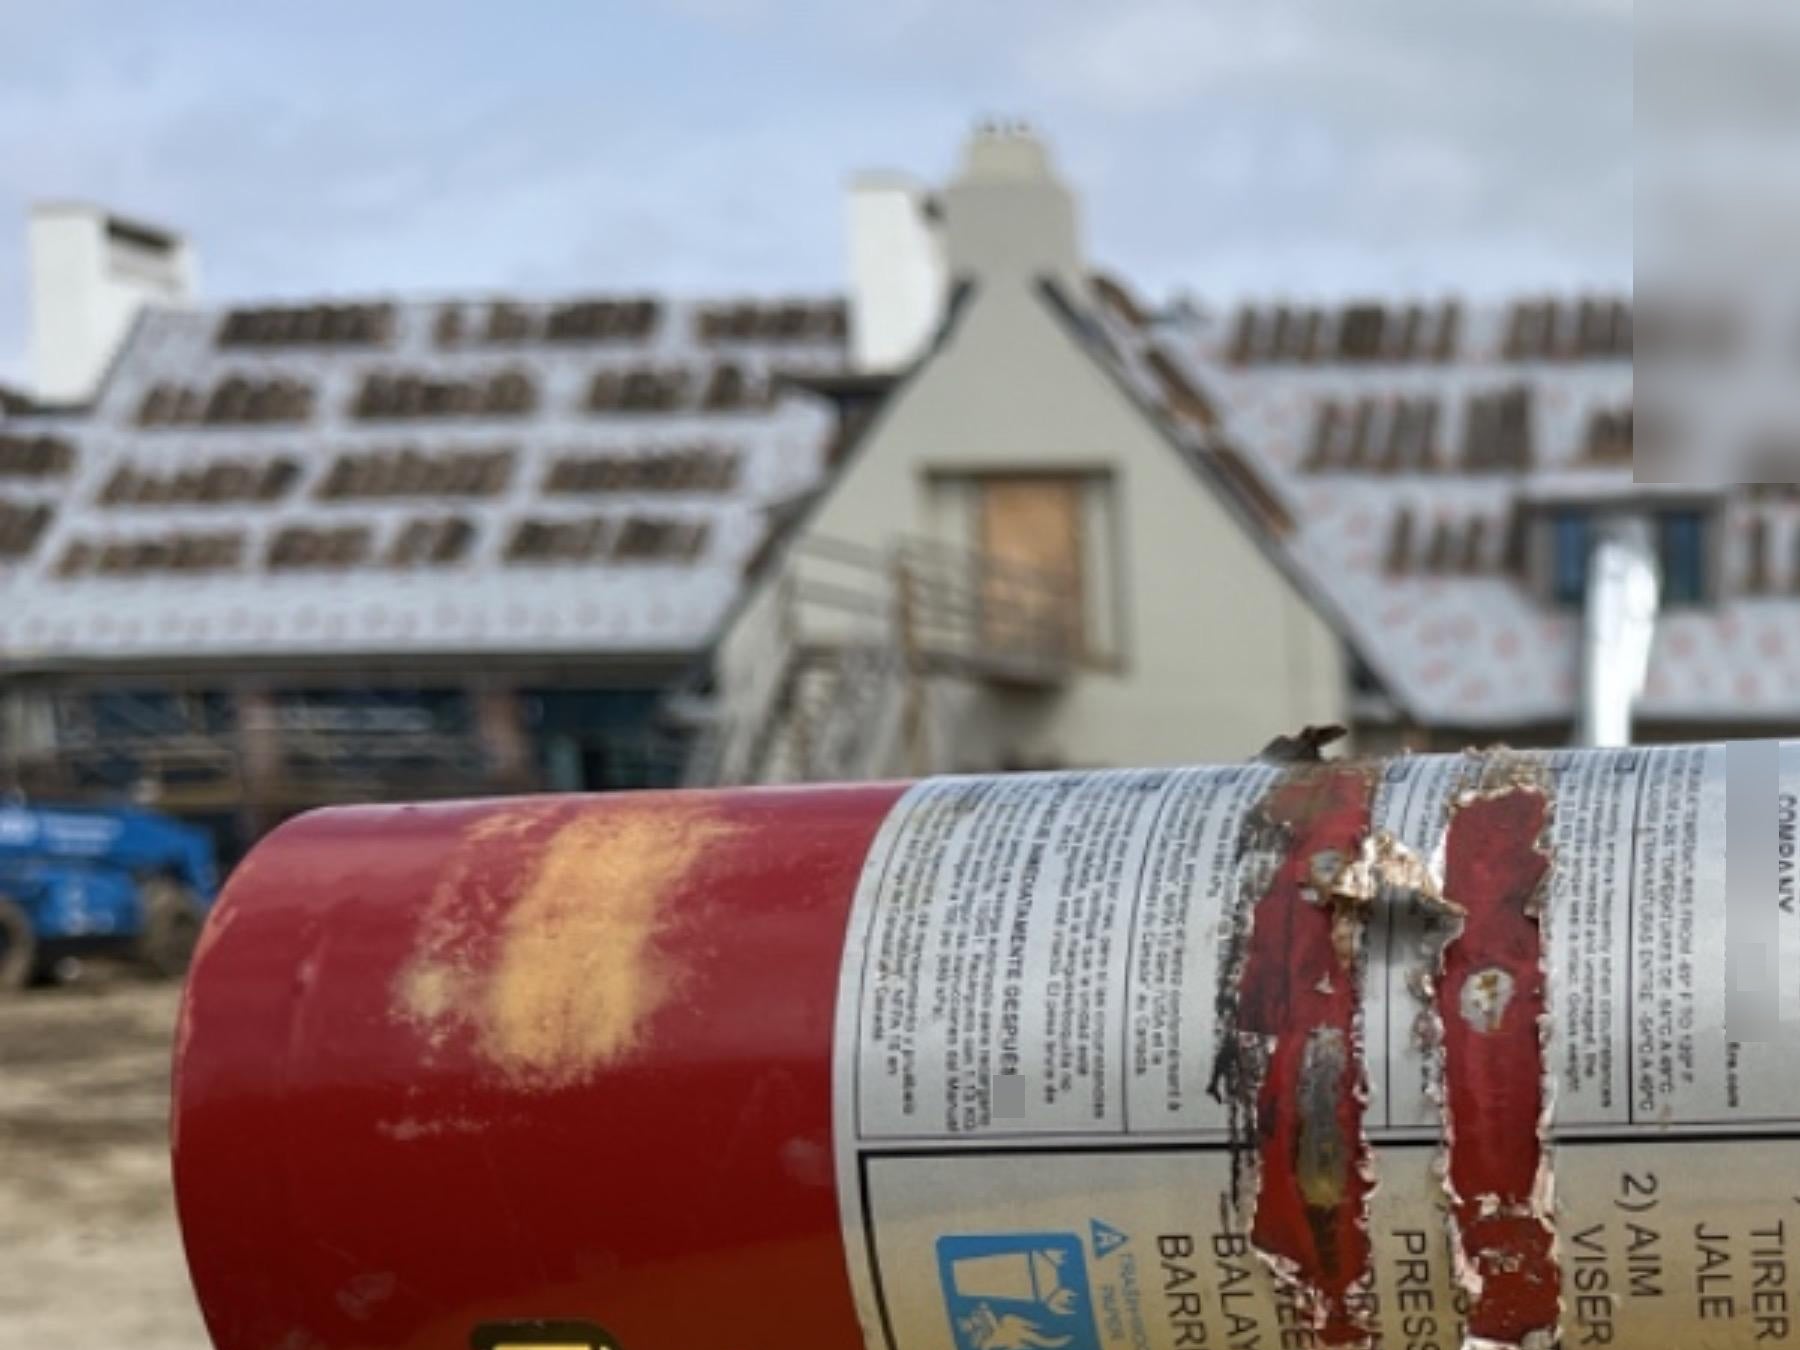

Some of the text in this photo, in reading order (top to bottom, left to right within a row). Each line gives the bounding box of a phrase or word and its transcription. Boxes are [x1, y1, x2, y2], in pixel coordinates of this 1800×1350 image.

[1571, 1223, 1614, 1347] VISER
[1614, 1172, 1664, 1298] 2) AIM
[1693, 1222, 1736, 1321] JALE
[1749, 1219, 1790, 1343] TIRER
